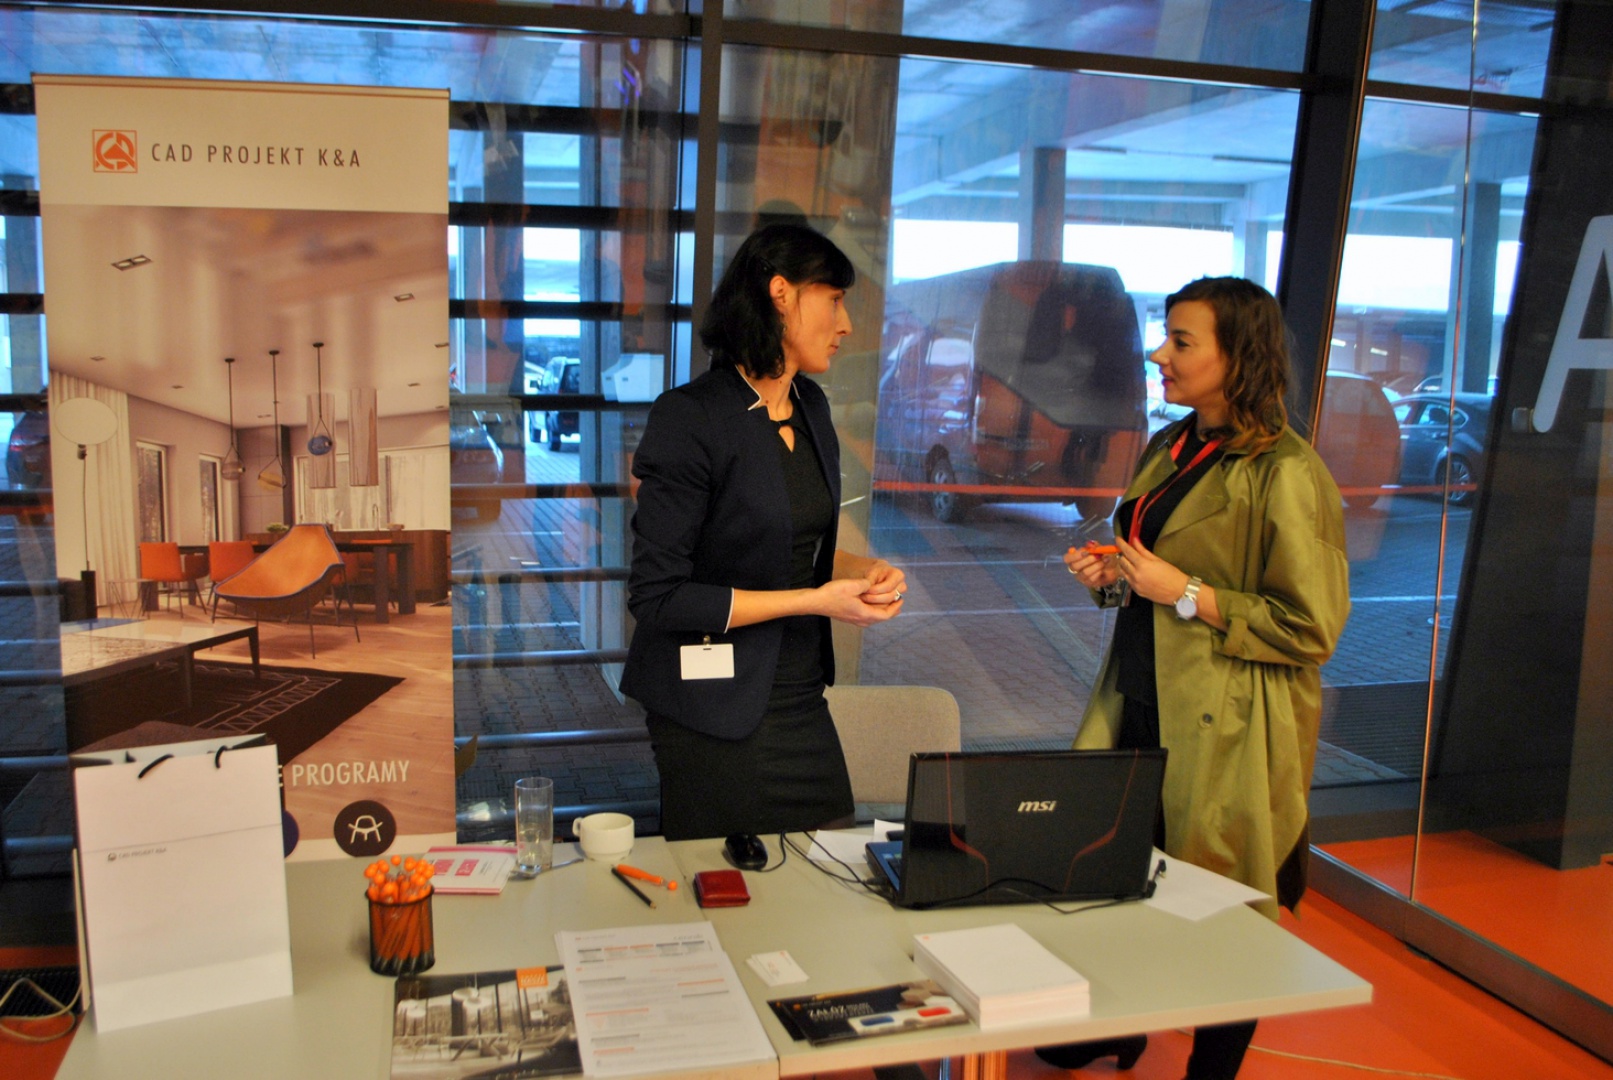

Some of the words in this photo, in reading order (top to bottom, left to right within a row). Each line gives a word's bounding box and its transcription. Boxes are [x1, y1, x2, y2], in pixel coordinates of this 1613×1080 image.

[151, 143, 193, 162] CAD
[207, 144, 304, 165] PROJEKT
[318, 148, 360, 167] K&A
[291, 759, 410, 786] PROGRAMY
[1017, 800, 1057, 812] msi
